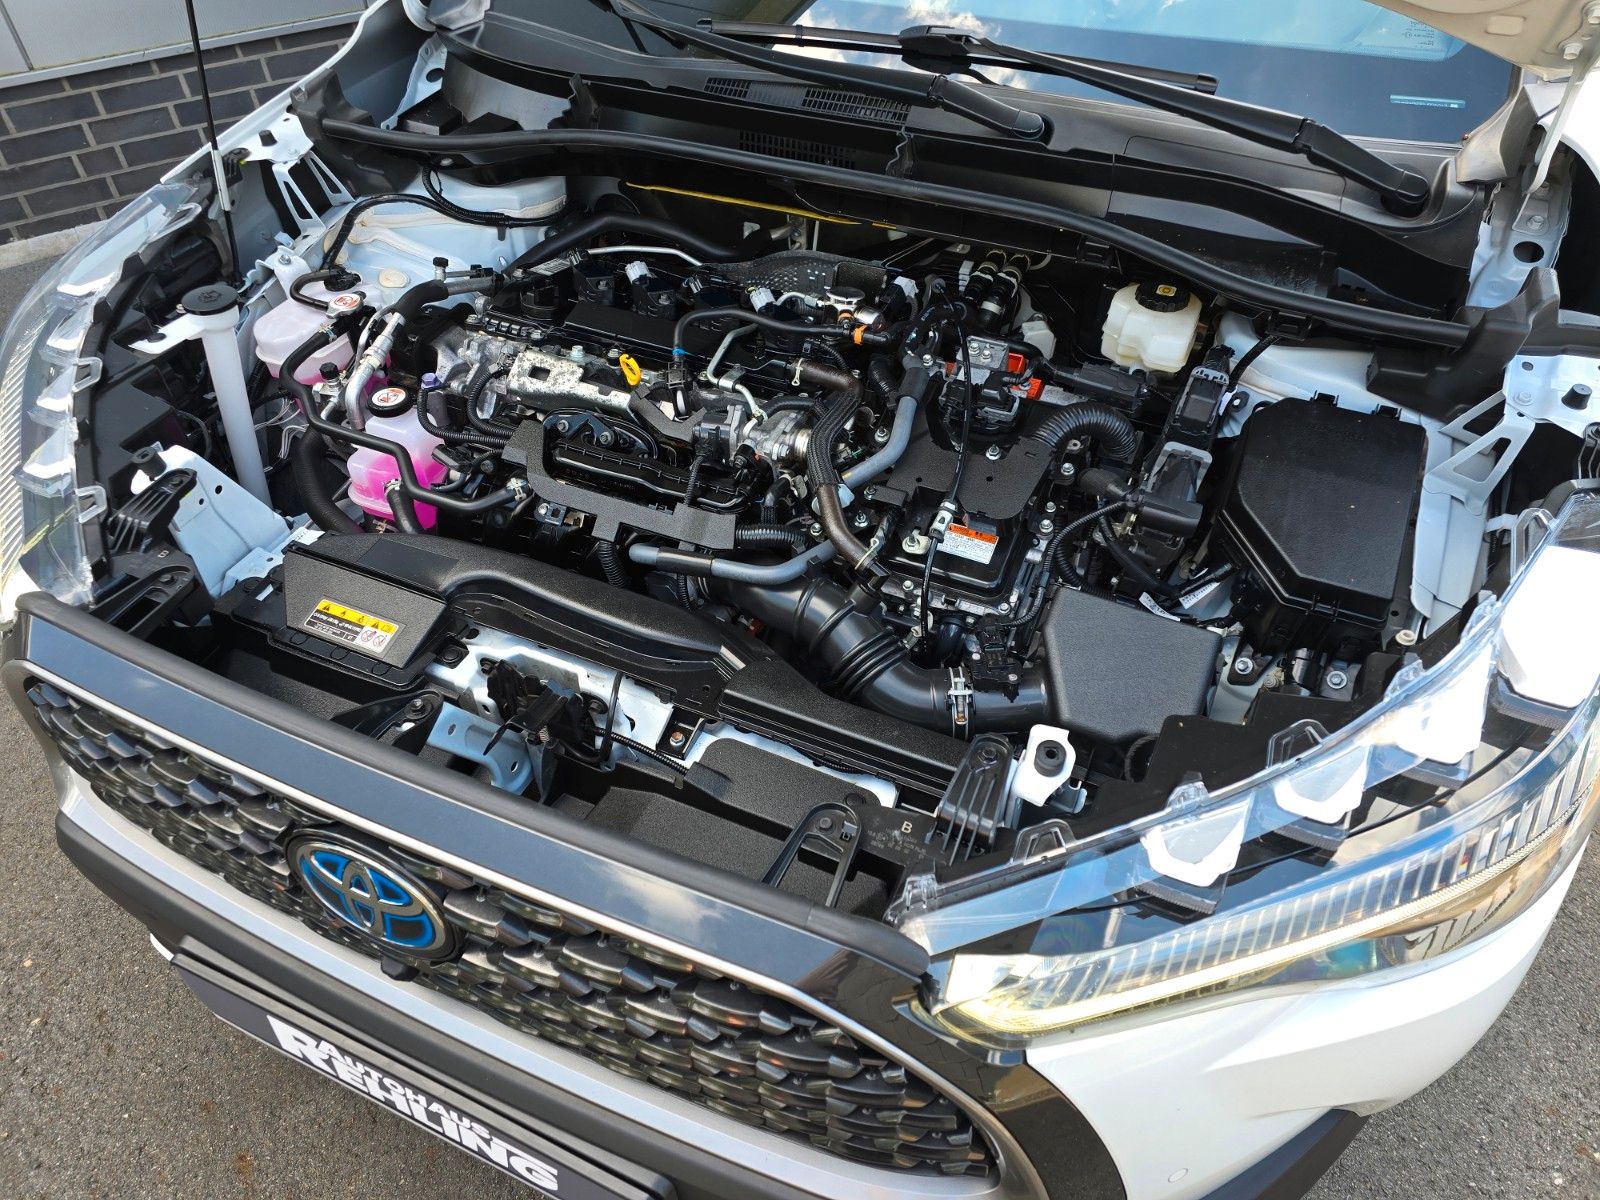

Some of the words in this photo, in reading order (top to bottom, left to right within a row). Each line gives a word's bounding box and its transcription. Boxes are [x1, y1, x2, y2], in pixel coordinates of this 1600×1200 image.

[901, 820, 913, 834] B
[266, 1014, 559, 1191] REHLING
[316, 1039, 491, 1140] AUTOHAUS
